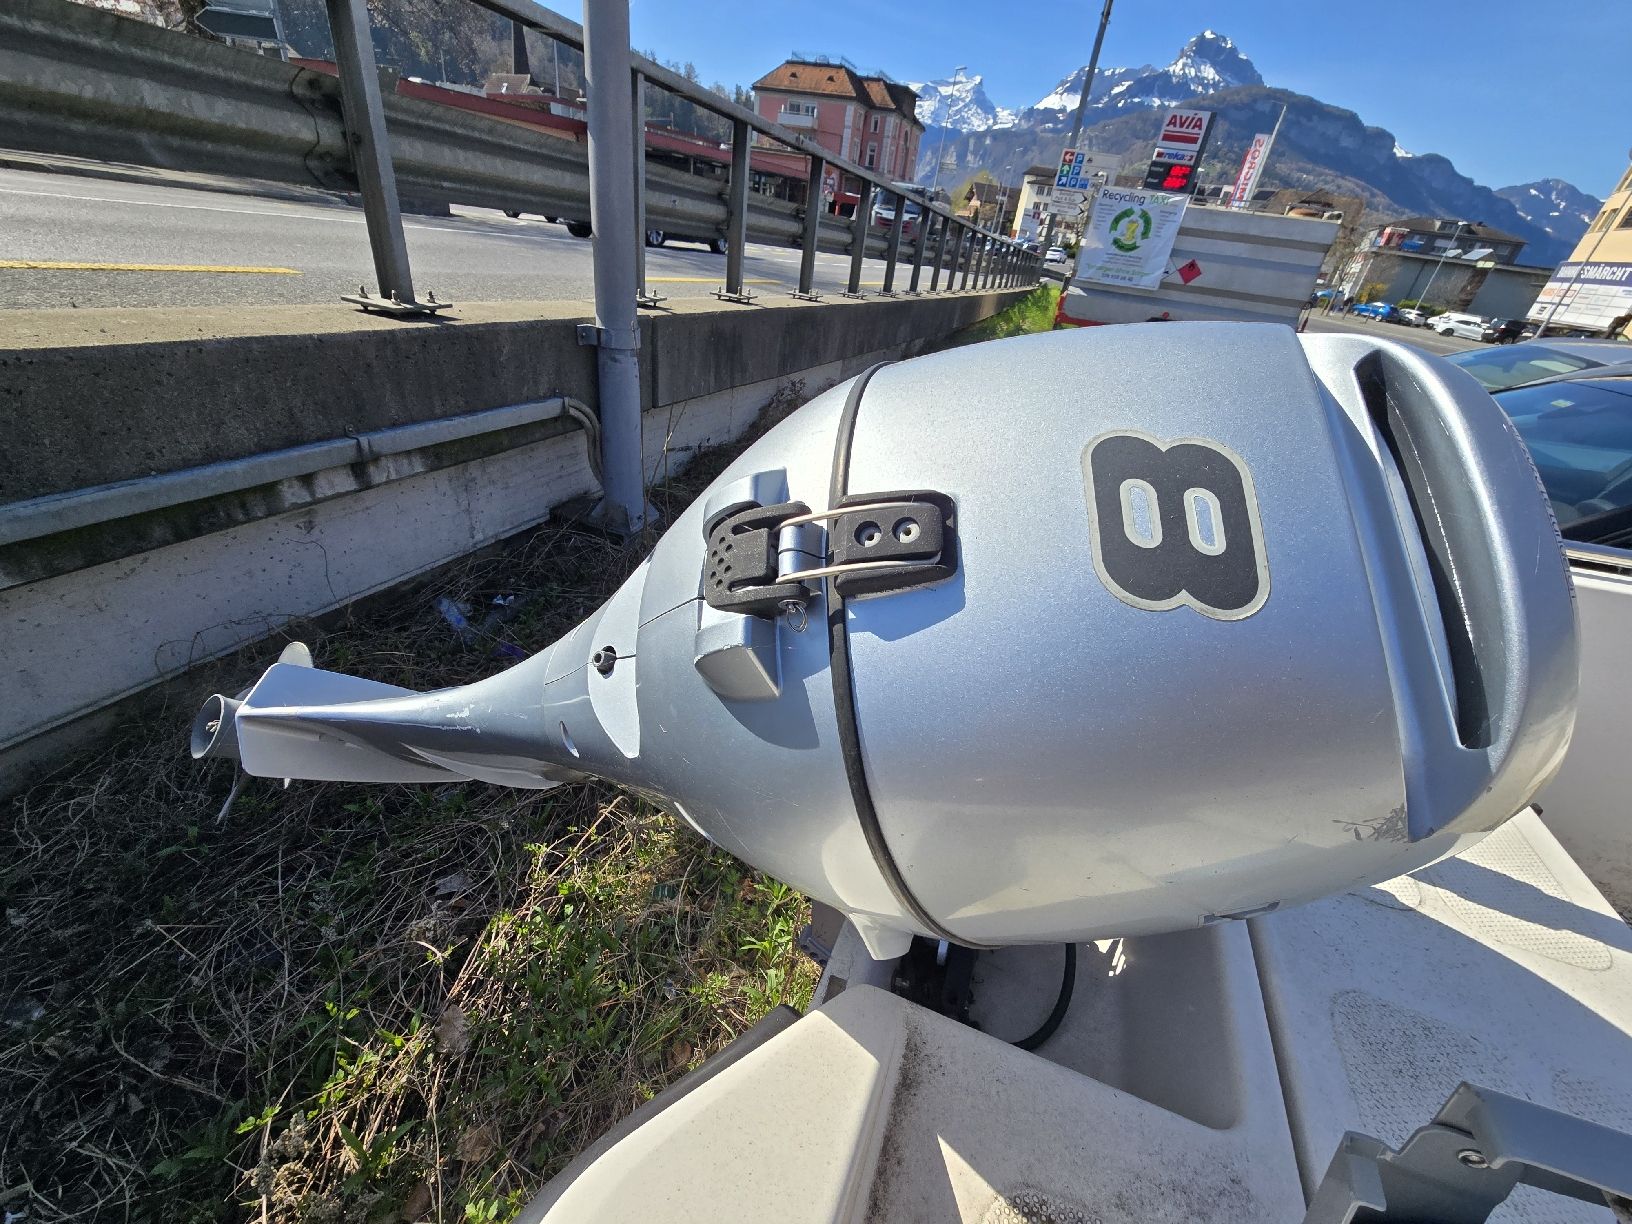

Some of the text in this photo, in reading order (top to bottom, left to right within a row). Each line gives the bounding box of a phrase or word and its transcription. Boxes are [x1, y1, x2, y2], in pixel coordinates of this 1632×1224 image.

[1166, 112, 1204, 131] AVIA
[1102, 189, 1146, 207] Recycling
[1080, 428, 1272, 623] 8
